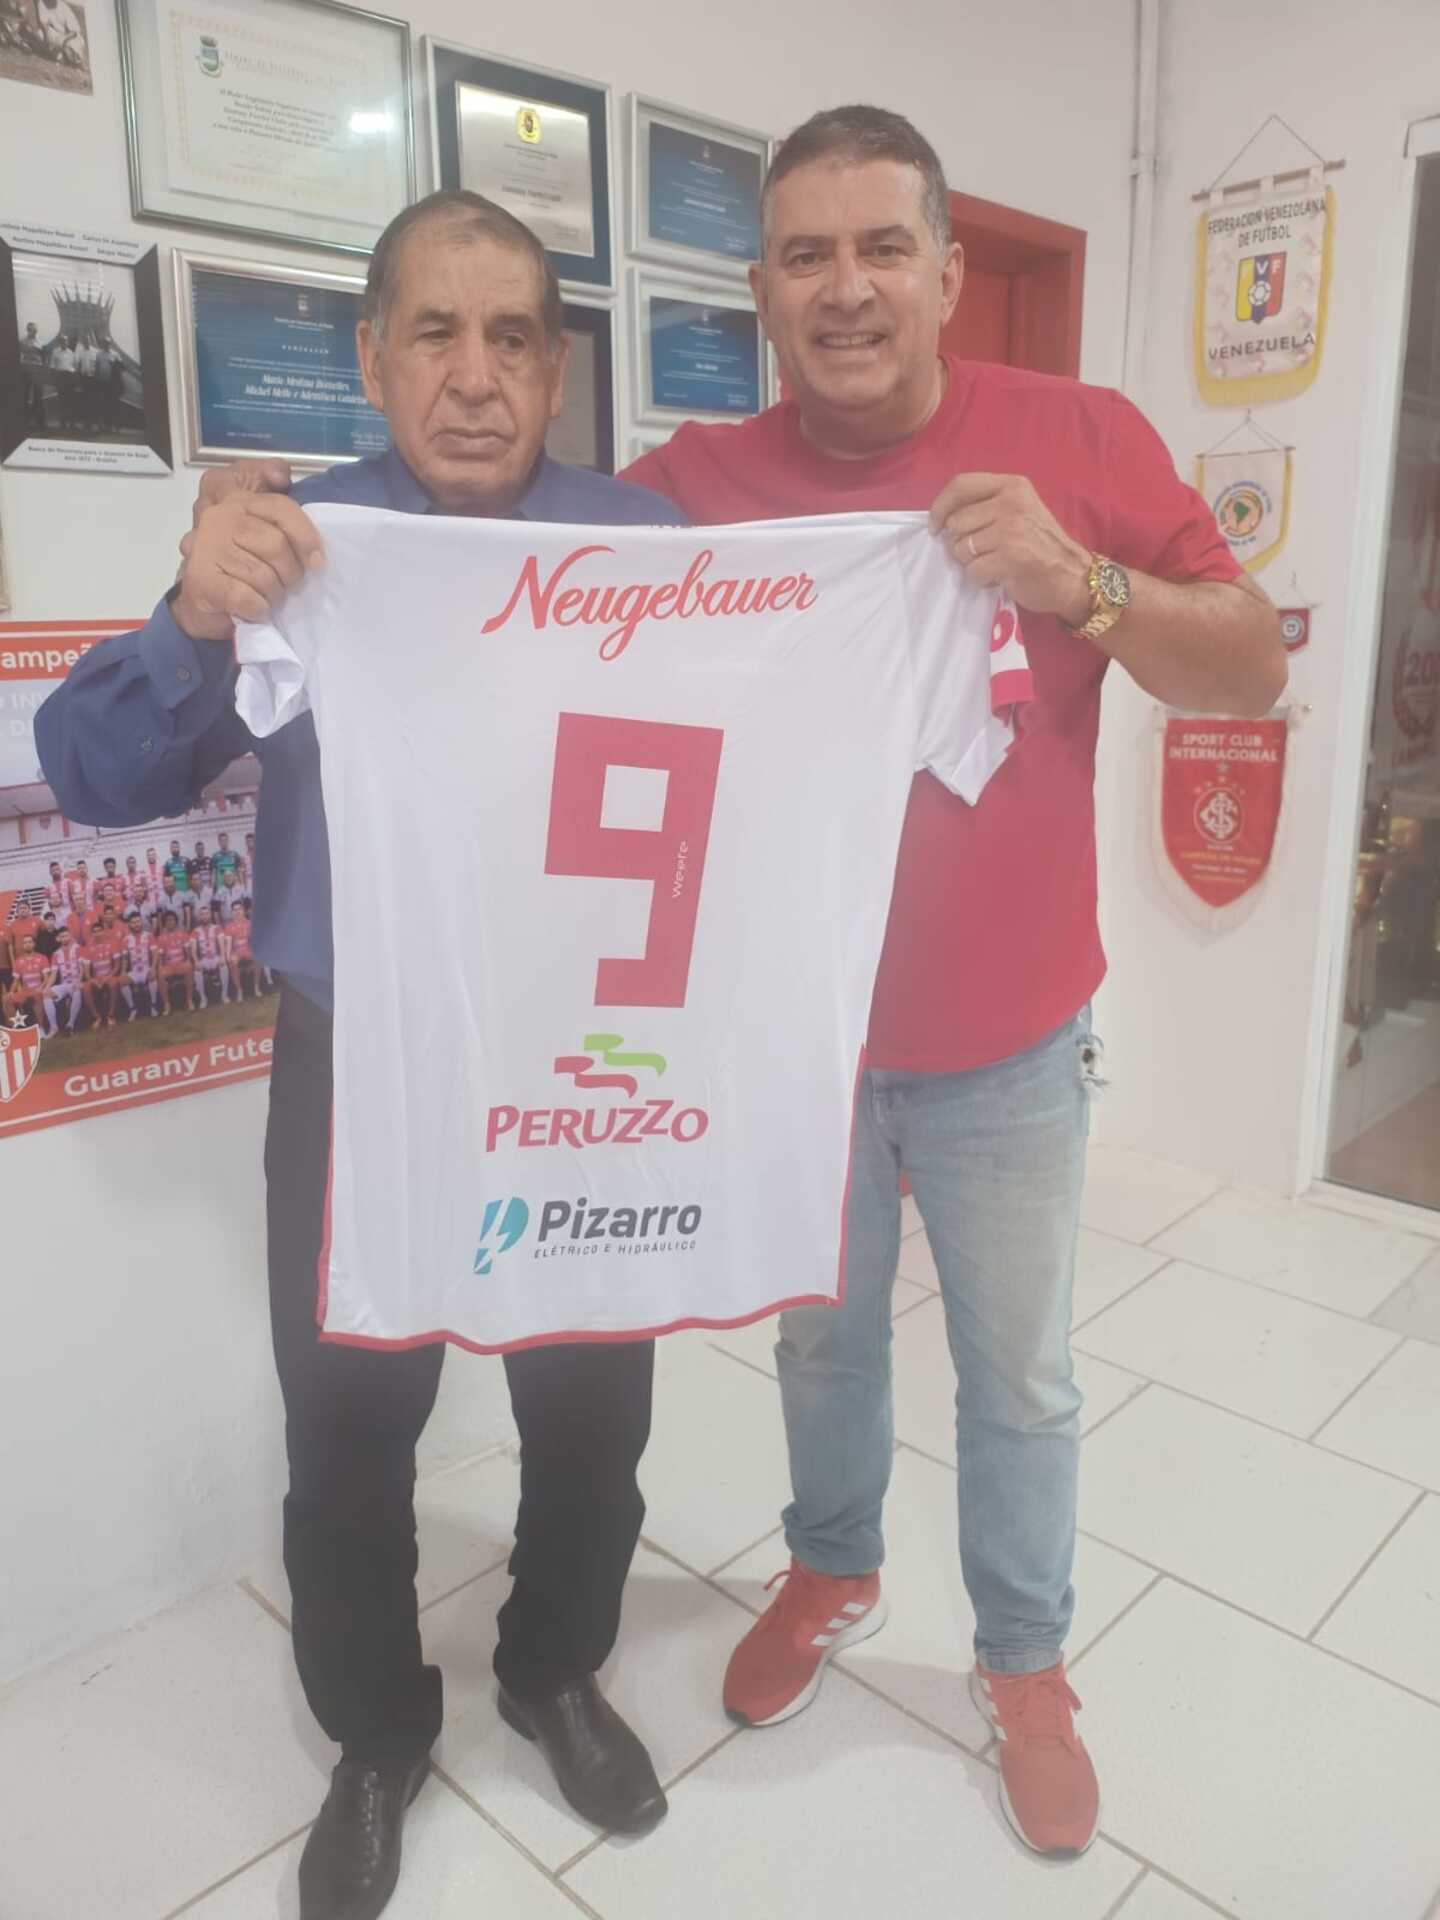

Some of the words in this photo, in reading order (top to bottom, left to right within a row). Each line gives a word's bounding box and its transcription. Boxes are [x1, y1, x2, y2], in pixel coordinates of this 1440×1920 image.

[1264, 199, 1326, 221] VENEZOLANA
[1238, 231, 1250, 248] DE
[1251, 224, 1292, 244] FUTBOL
[1208, 332, 1316, 360] VENEZUELA
[480, 544, 819, 662] Neugebauer
[1182, 733, 1226, 745] SPORT
[1230, 733, 1264, 746] CLUB
[1168, 746, 1278, 762] INTERNACIONAL
[543, 711, 725, 1008] 9
[64, 1052, 201, 1097] Guarany
[486, 1099, 710, 1153] PERUZZO
[538, 1197, 702, 1242] Pizarro
[534, 1244, 597, 1260] ELÉTRICO
[618, 1240, 697, 1256] HIDRÁULICO
